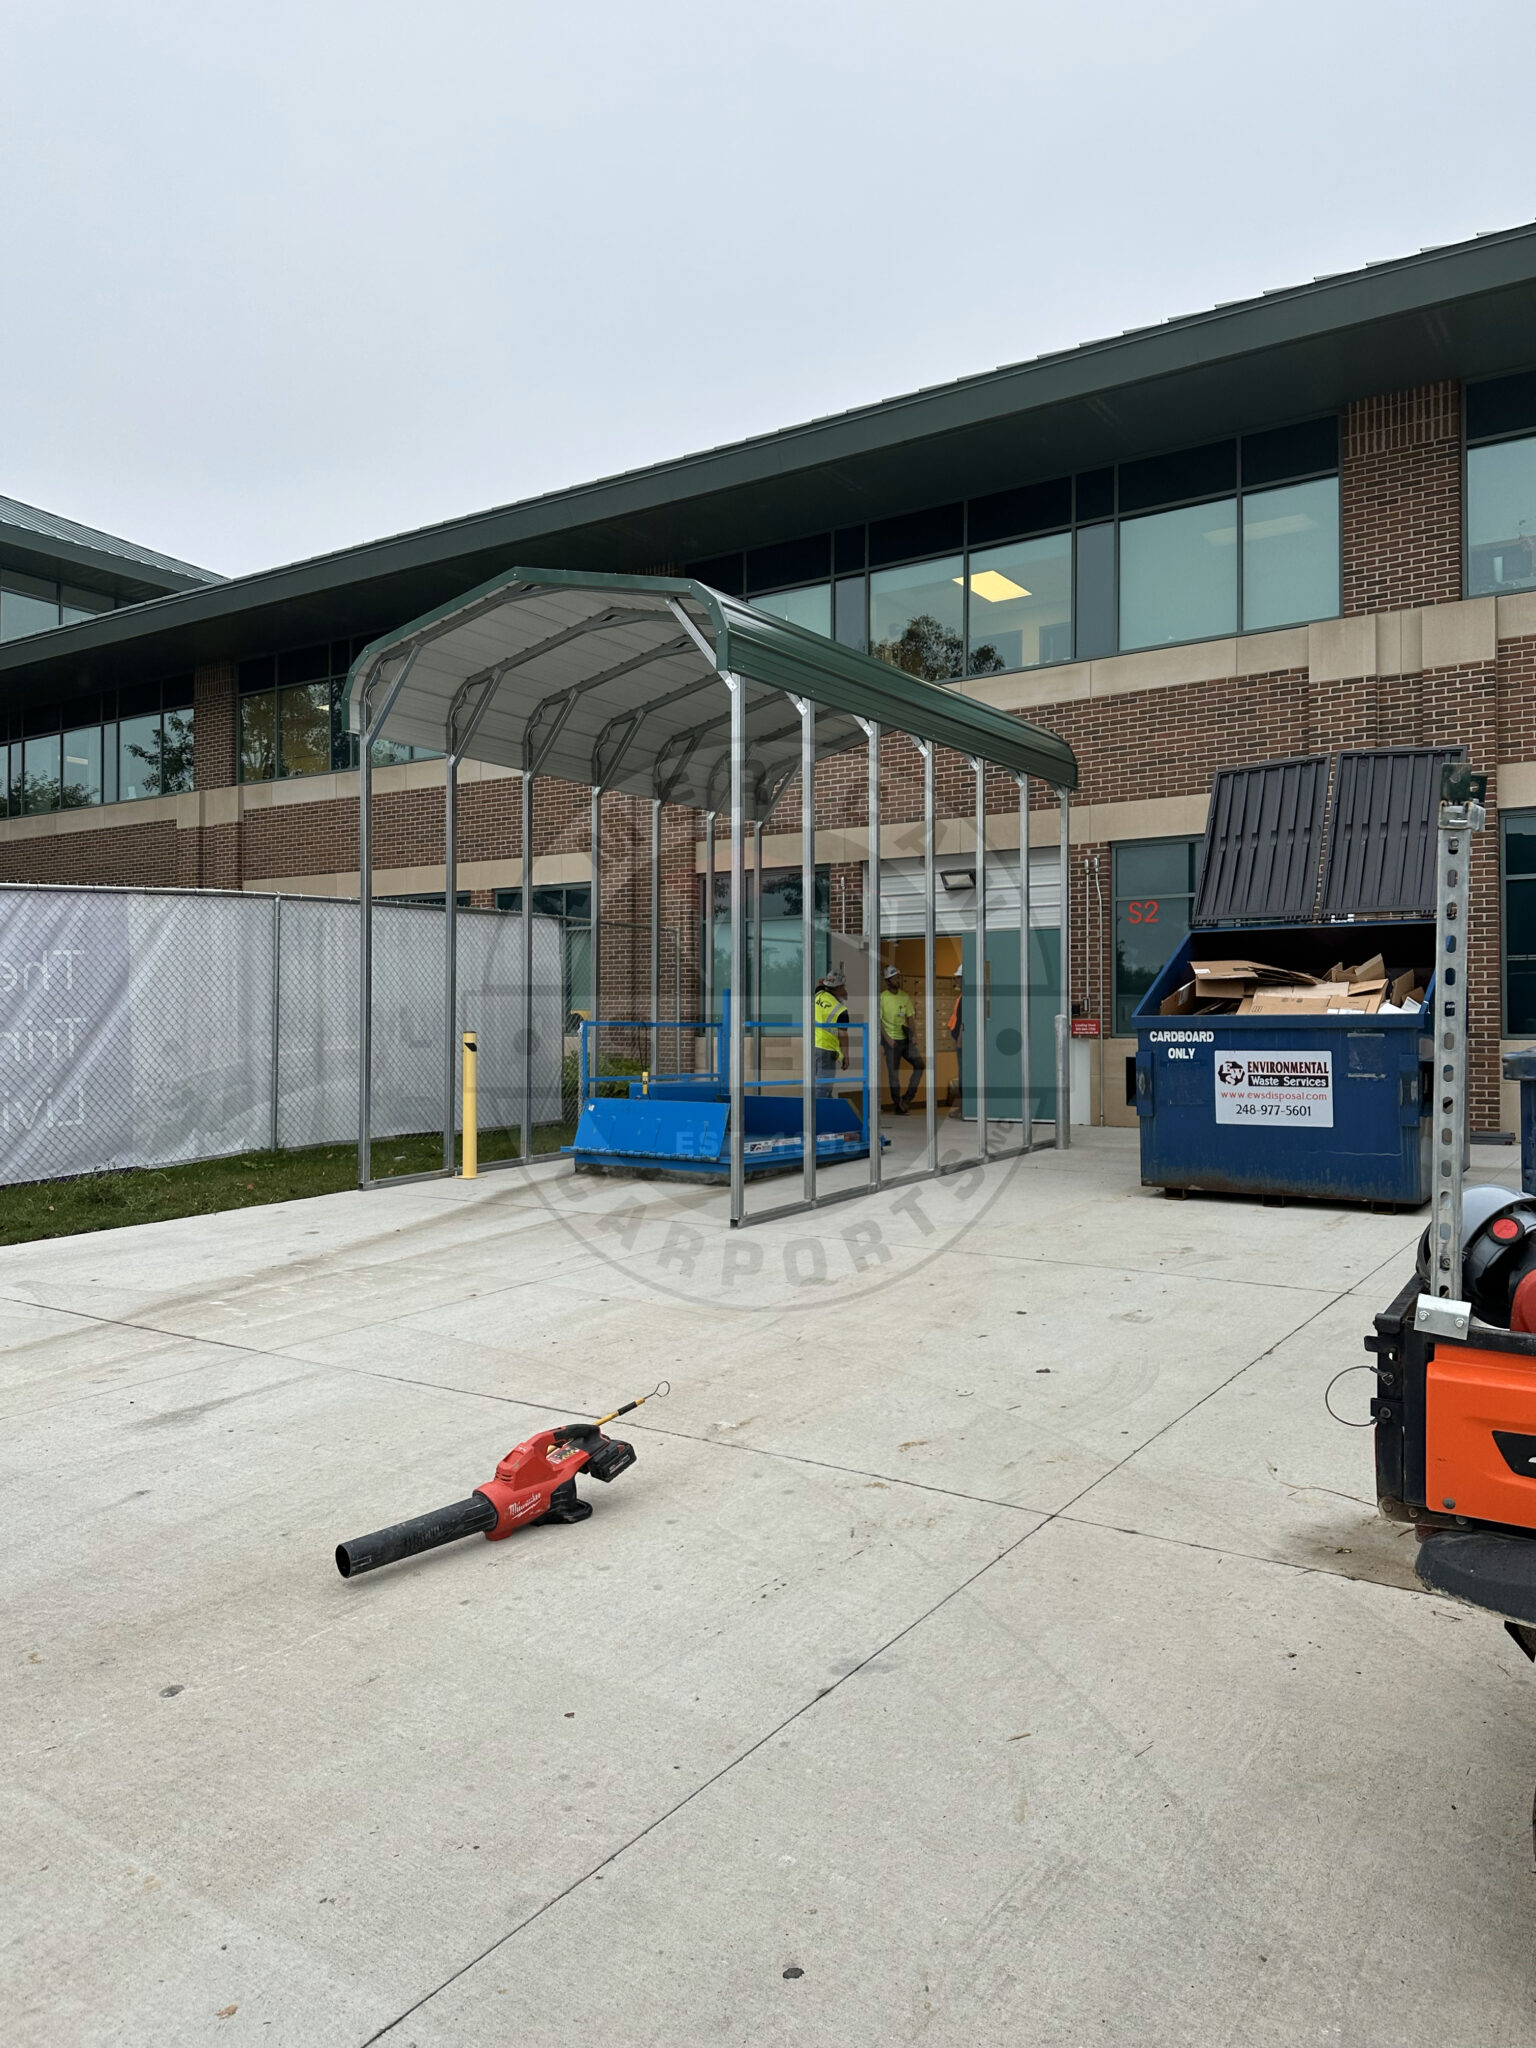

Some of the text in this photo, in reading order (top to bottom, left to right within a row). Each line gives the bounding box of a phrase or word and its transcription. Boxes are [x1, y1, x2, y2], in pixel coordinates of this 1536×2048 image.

[1128, 900, 1159, 925] S2
[1150, 1031, 1214, 1043] CARDBOARD
[1168, 1048, 1195, 1059] ONLY
[1247, 1061, 1329, 1074] ENVIRONMENTAL
[1251, 1077, 1326, 1087] Waste Services
[1235, 1104, 1311, 1116] 248-977-5601
